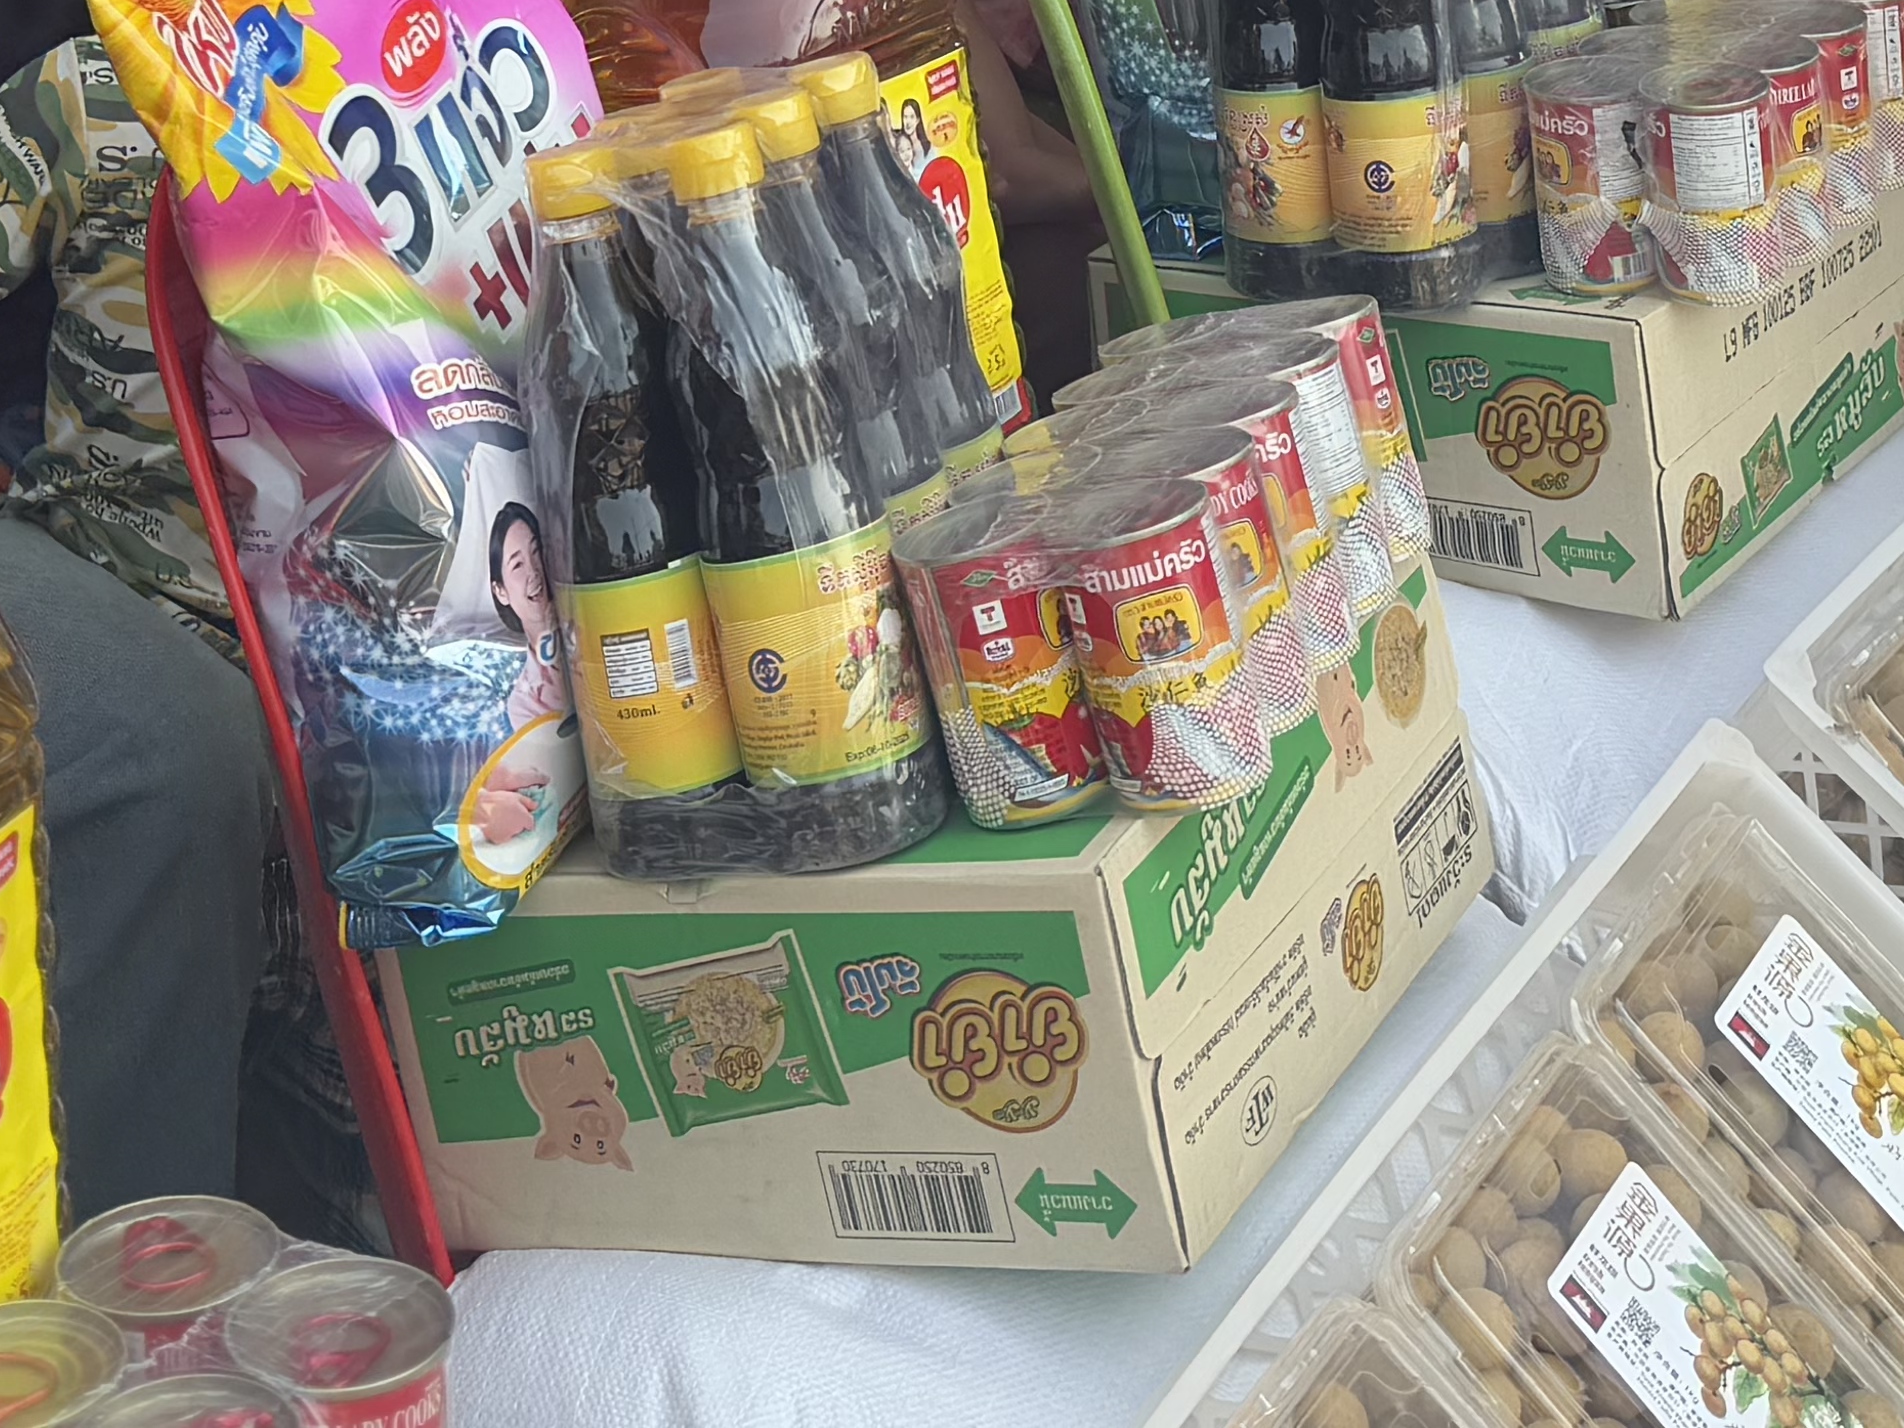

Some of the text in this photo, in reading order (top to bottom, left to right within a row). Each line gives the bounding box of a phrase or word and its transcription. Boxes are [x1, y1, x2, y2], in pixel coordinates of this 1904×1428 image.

[384, 9, 442, 77] พลัง
[1084, 537, 1206, 595] สามแม่ครัว
[1416, 841, 1473, 931] ระวังแตก!
[452, 1004, 597, 1070] รสหมูสับ
[911, 981, 1086, 1103] ยำยำ
[1037, 1187, 1117, 1222] วางแนวนี้
[1597, 1177, 1665, 1262] 金果源
